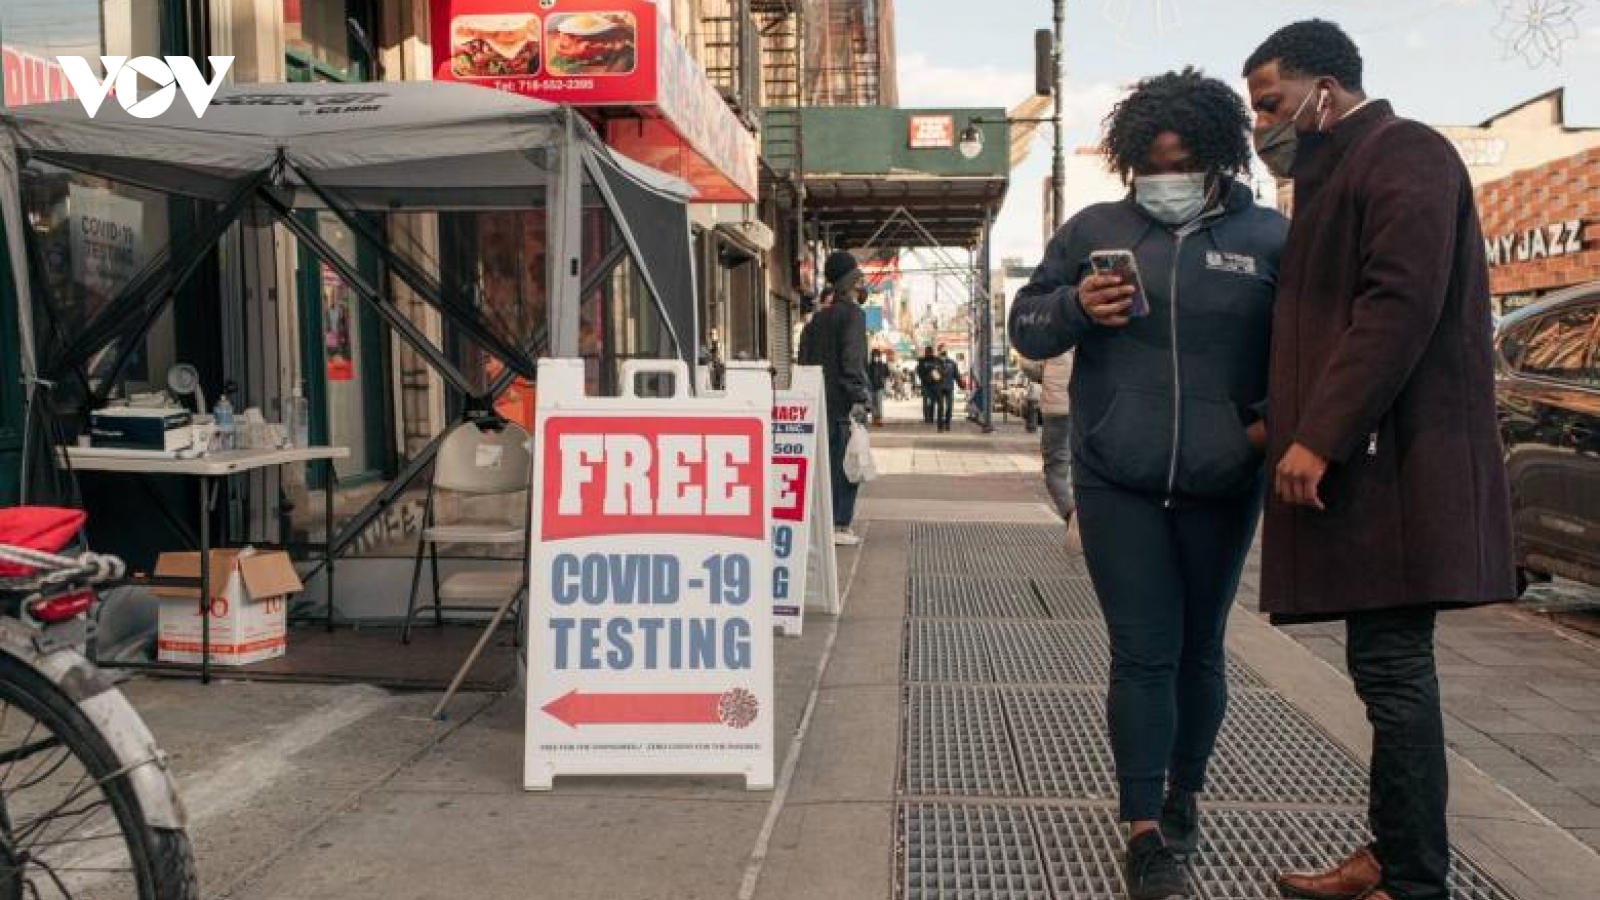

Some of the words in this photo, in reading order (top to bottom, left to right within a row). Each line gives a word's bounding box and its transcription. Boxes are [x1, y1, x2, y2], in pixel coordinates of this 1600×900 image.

[1517, 219, 1581, 261] JAZZ
[557, 434, 751, 516] FREE
[551, 554, 680, 606] COVID
[688, 554, 751, 606] -19
[549, 617, 752, 670] TESTING
